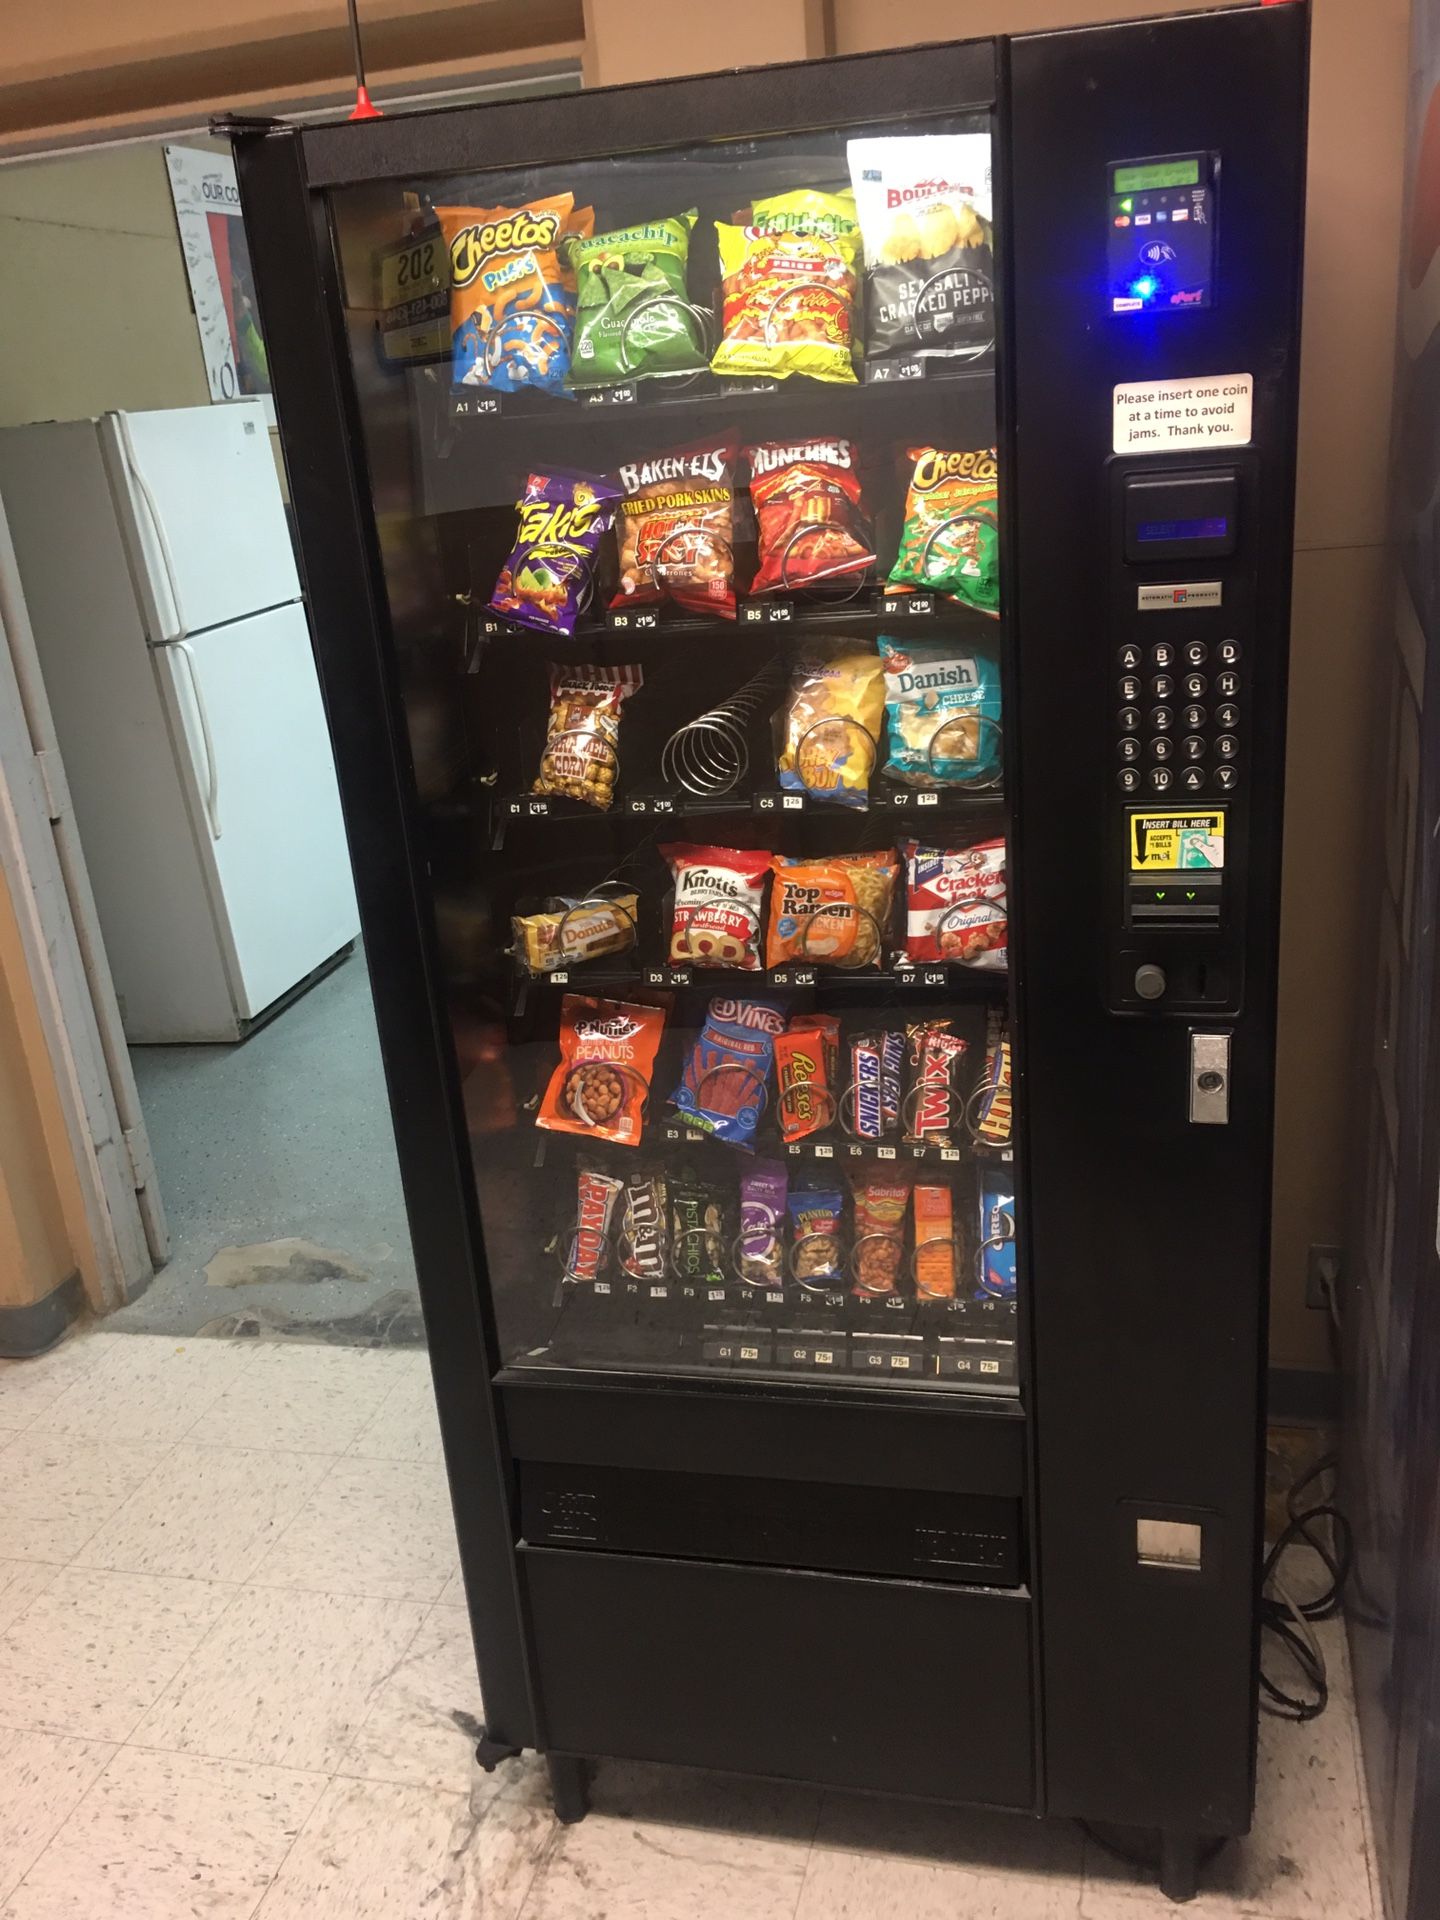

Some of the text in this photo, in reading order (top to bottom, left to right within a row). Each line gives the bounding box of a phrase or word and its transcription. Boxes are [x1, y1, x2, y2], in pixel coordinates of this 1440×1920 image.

[202, 182, 224, 200] OUR
[450, 210, 557, 284] Cheetos
[774, 260, 813, 271] FRIES
[879, 293, 948, 323] CRACKED
[580, 341, 593, 353] 220
[873, 368, 890, 380] A7
[589, 393, 604, 403] A3
[1116, 383, 1248, 405] Please insert one coin
[455, 402, 469, 414] A1
[1128, 402, 1236, 422] at a time to avoid
[1128, 423, 1234, 442] jams. Thank you.
[752, 440, 852, 477] MUNCHIES
[621, 487, 731, 516] FRIED PORK SKINS
[515, 500, 601, 545] Takis
[640, 519, 674, 540] HOT
[711, 581, 725, 590] 150
[885, 602, 898, 612] B7
[747, 610, 762, 620] B5
[485, 622, 498, 632] B1
[614, 616, 629, 627] B3
[1124, 645, 1235, 662] A B C D
[897, 664, 973, 694] Danish
[1124, 677, 1234, 694] E F G H
[942, 690, 985, 706] CHEESE
[1125, 709, 1232, 725] 1 2 3 4
[1124, 740, 1231, 755] 5 6 7 8
[553, 755, 588, 780] CORN
[801, 766, 840, 790] BUN
[1124, 772, 1169, 785] 9 10
[760, 798, 774, 808] C5
[893, 795, 908, 805] C7
[510, 804, 521, 814] C1
[632, 802, 646, 812] C3
[1142, 819, 1170, 830] INSERT
[1171, 819, 1188, 829] BILL
[1190, 818, 1211, 828] HERE
[1149, 834, 1173, 842] ACCEPTS
[1155, 841, 1172, 849] BILLS
[682, 867, 738, 898] Knott's
[783, 883, 820, 901] Top
[944, 890, 987, 907] Jack
[782, 900, 852, 919] Ramen
[947, 910, 993, 931] Original
[564, 918, 616, 946] Donuts
[649, 973, 663, 983] D3
[774, 973, 788, 983] D5
[902, 973, 916, 983] D7
[736, 1000, 785, 1035] VINES
[576, 1044, 635, 1060] PEANUTS
[743, 1043, 756, 1052] RED
[791, 1050, 816, 1121] Reese's
[857, 1053, 881, 1138] SNICKERS
[667, 1129, 679, 1139] E3
[788, 1145, 801, 1154] E5
[850, 1147, 862, 1156] E6
[913, 1148, 926, 1157] E7
[868, 1186, 907, 1198] Sabritas
[990, 1204, 1004, 1251] OREO
[686, 1196, 701, 1274] PISTACHIOS
[627, 1284, 638, 1293] F2
[684, 1287, 695, 1297] F3
[741, 1291, 753, 1300] F4
[800, 1294, 812, 1303] F5
[719, 1347, 732, 1357] G1
[793, 1349, 807, 1359] G2
[868, 1355, 882, 1365] G3
[957, 1360, 971, 1370] G4
